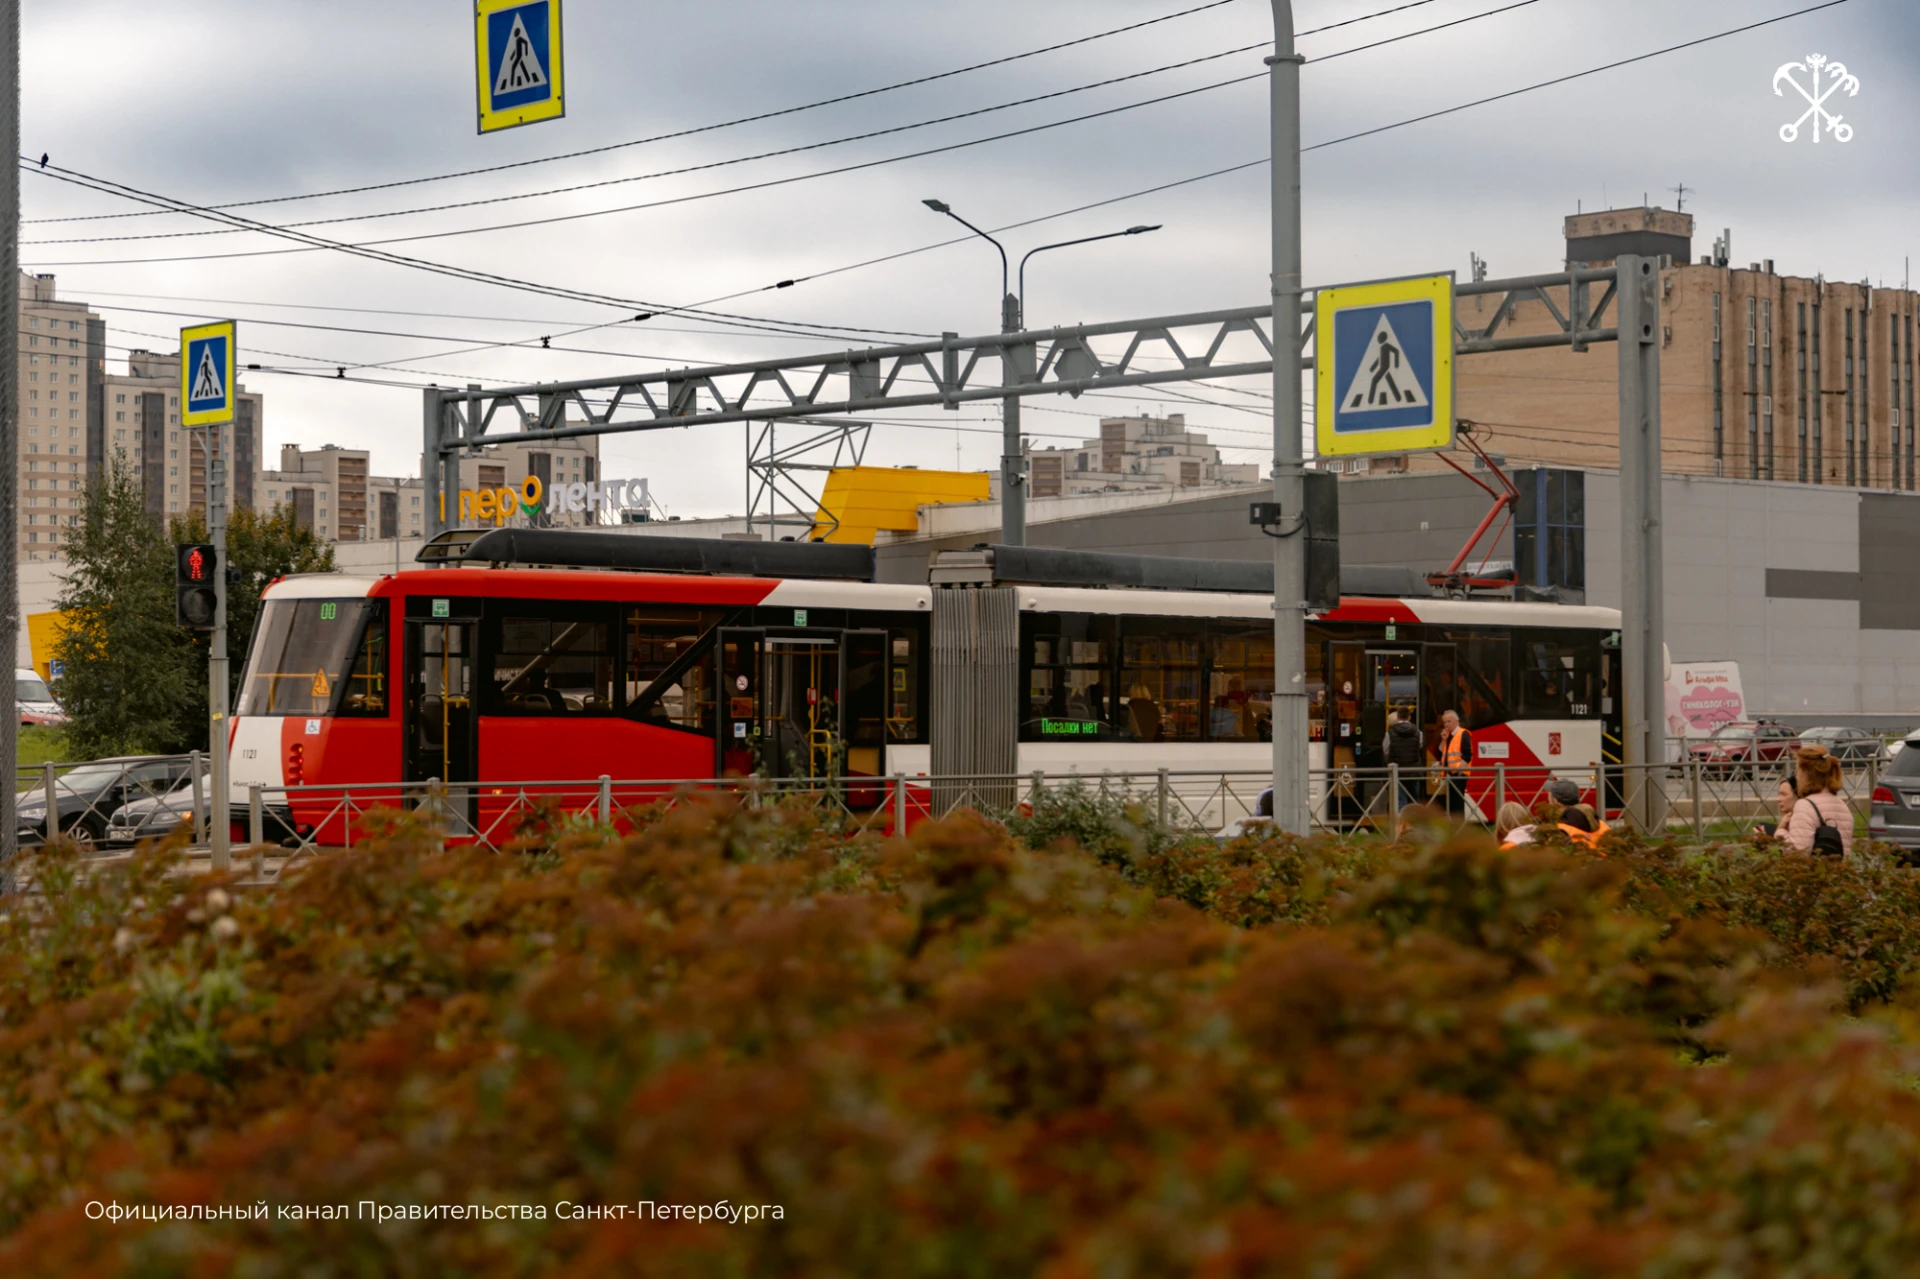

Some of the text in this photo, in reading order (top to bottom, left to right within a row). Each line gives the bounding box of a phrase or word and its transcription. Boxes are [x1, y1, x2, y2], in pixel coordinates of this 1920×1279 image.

[546, 478, 651, 514] лента
[321, 602, 337, 620] 00
[1571, 704, 1588, 715] 1121
[1041, 718, 1099, 734] Посадки нет
[242, 749, 257, 759] 1121
